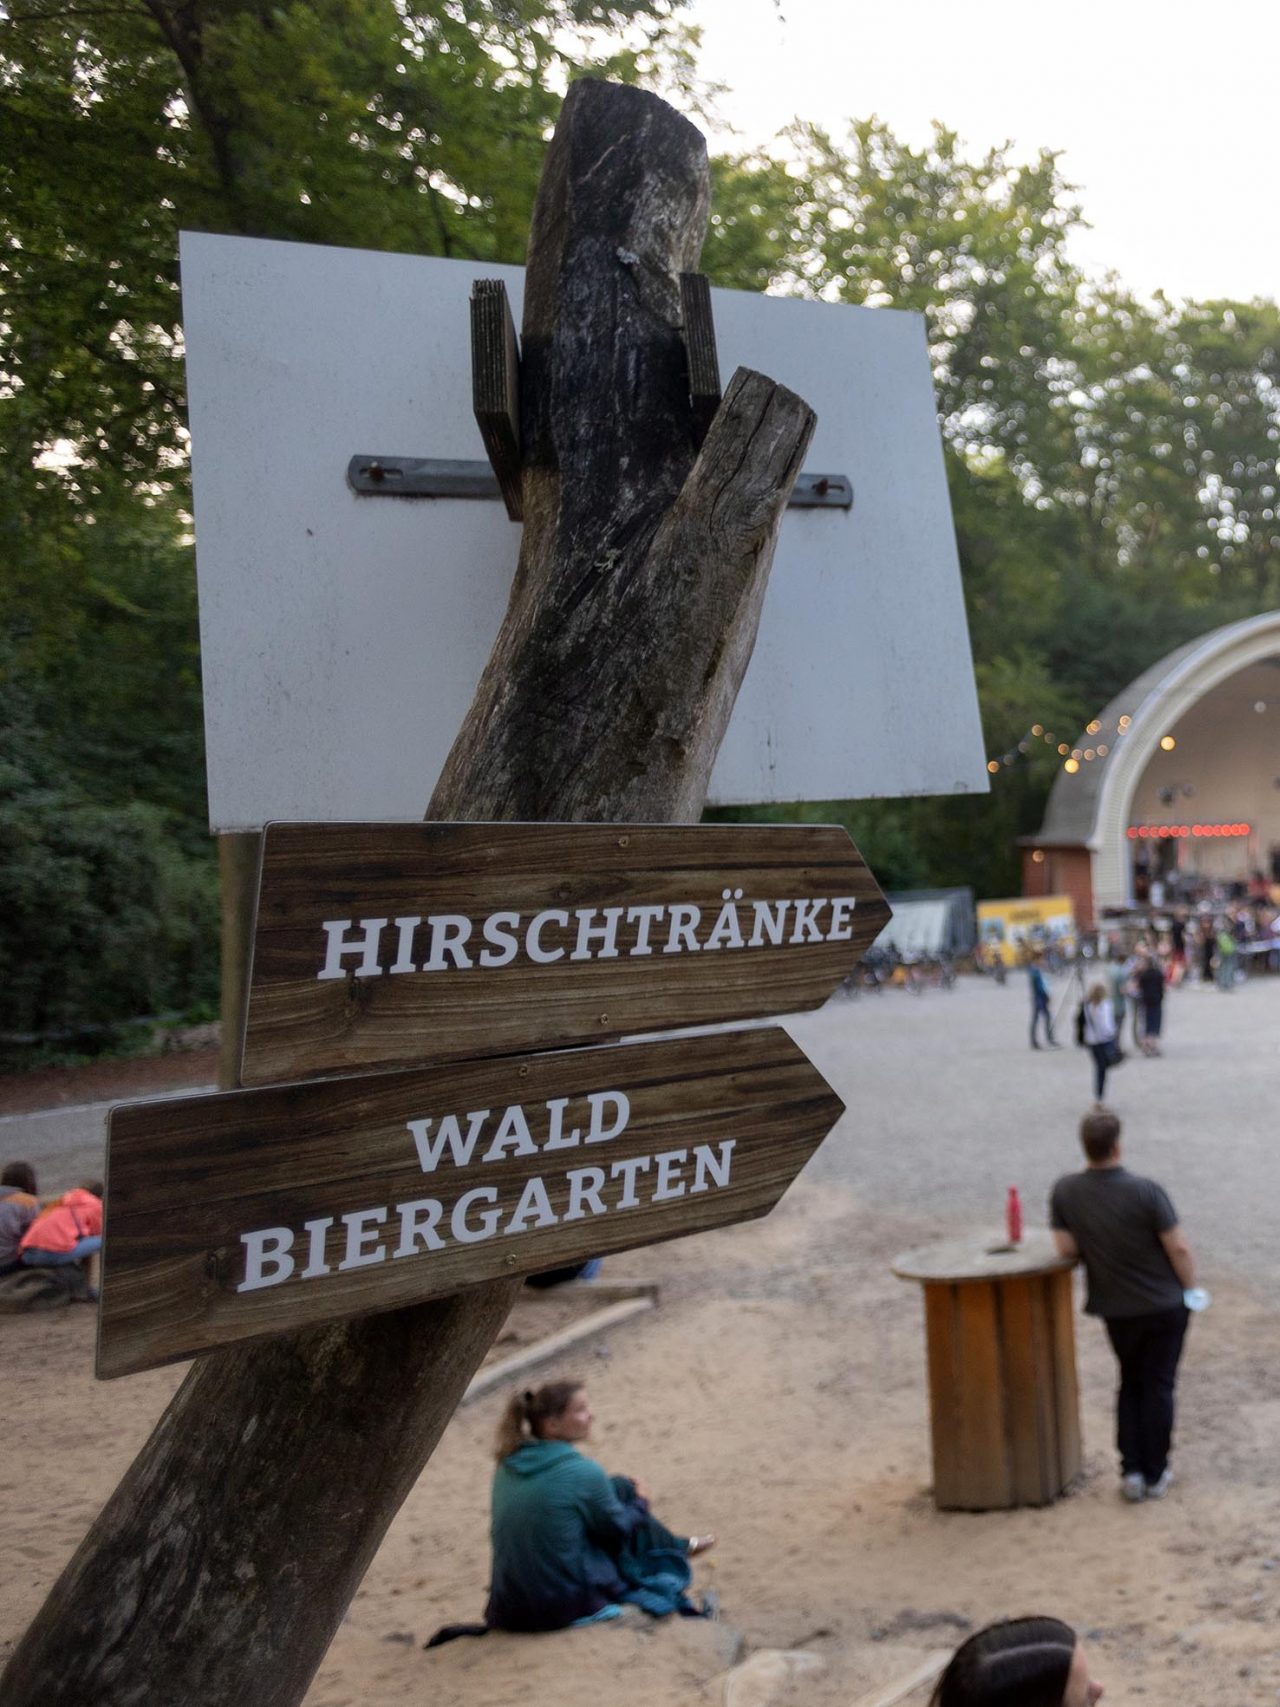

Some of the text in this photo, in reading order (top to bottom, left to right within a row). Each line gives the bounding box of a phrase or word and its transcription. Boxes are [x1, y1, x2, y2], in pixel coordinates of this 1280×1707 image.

[317, 888, 856, 980] HIRSCHTRÄNKE
[406, 1091, 630, 1173] WALD
[237, 1139, 737, 1292] BIERGARTEN
